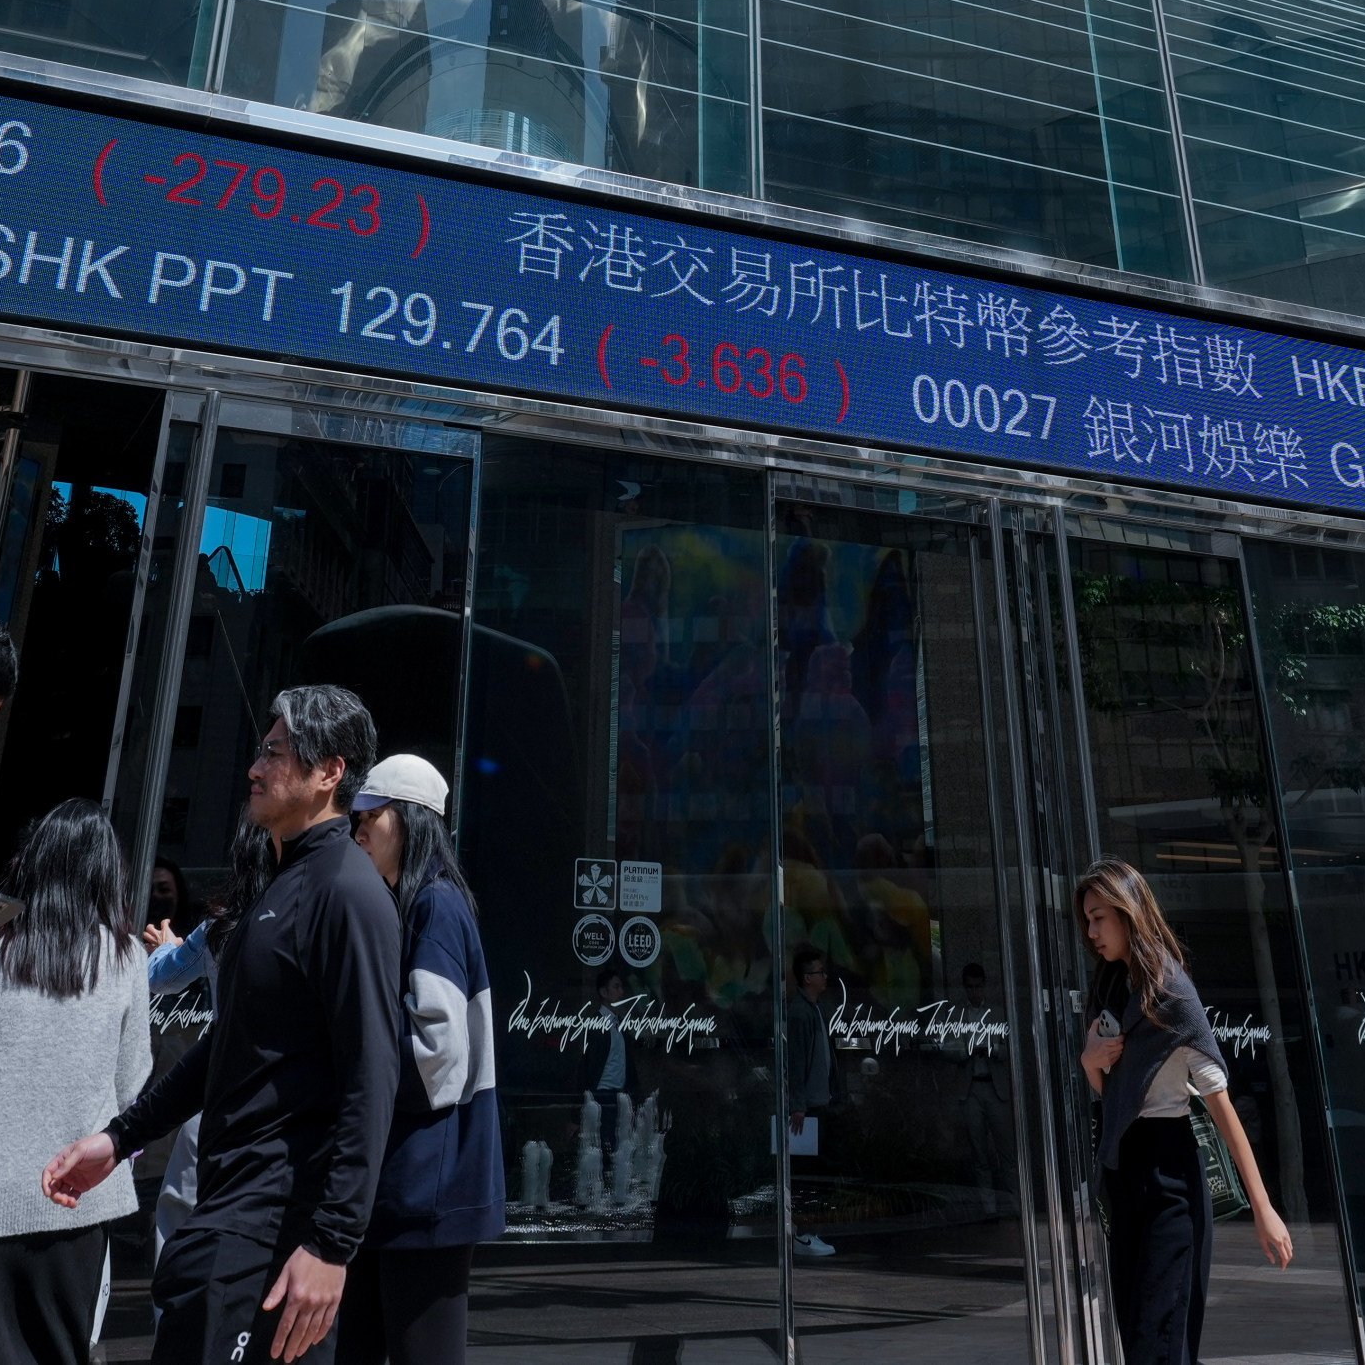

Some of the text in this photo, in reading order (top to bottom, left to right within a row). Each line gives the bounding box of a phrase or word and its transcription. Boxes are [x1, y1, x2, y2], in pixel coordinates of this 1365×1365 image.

[148, 251, 294, 322] PPT
[333, 282, 565, 365] 129.764
[512, 213, 1260, 397] 香港交易所比特幣參考指數
[912, 374, 1057, 439] 00027
[1084, 396, 1308, 488] 銀河娛樂
[583, 932, 606, 942] WELL
[628, 933, 653, 948] LEED
